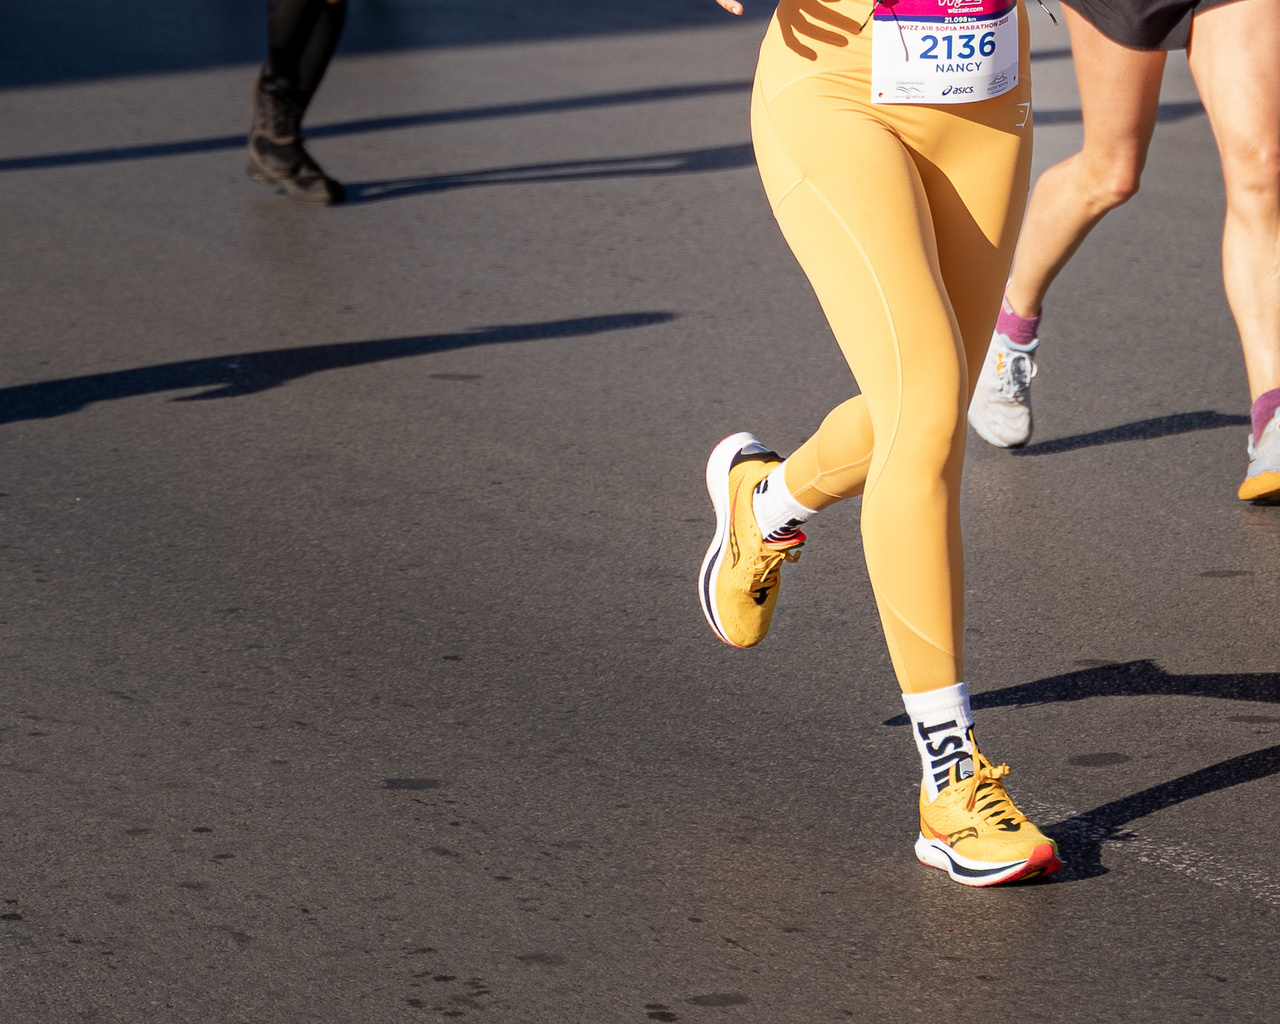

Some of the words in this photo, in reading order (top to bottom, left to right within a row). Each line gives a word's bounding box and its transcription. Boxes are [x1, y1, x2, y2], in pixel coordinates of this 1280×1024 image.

[960, 21, 998, 31] MARATHON
[919, 31, 996, 60] 2136
[935, 61, 983, 73] NANCY
